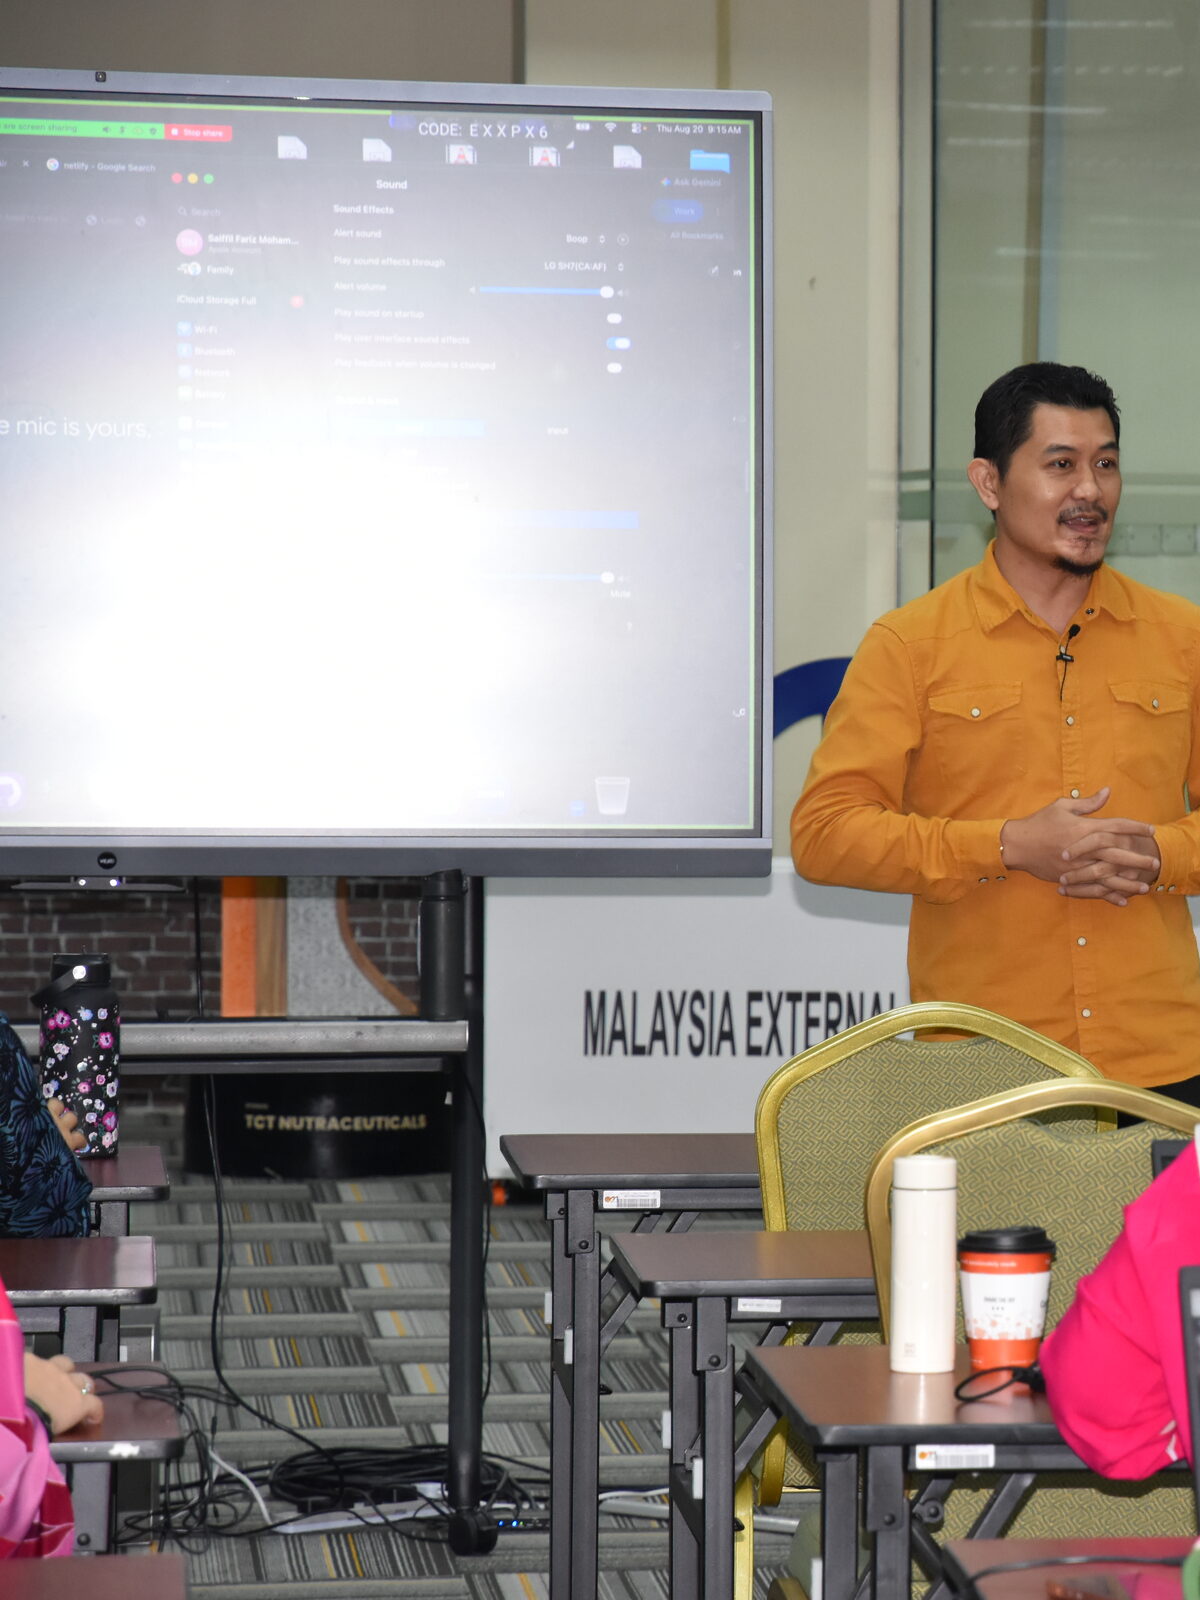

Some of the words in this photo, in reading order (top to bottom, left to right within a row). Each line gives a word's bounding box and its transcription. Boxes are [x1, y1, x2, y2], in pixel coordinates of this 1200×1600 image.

[418, 121, 463, 137] CODE:
[656, 124, 673, 134] Thu
[674, 124, 691, 136] Aug
[692, 125, 704, 134] 20
[97, 162, 126, 173] Google
[128, 163, 156, 173] Search
[376, 178, 408, 191] Sound
[333, 203, 362, 214] Sound
[363, 204, 395, 215] Effects
[333, 228, 354, 238] Alert
[355, 229, 382, 239] sound
[353, 257, 380, 266] sound
[381, 257, 411, 267] effects
[412, 257, 446, 269] through
[207, 264, 234, 276] Family
[16, 416, 57, 437] mic
[63, 417, 80, 437] is
[583, 989, 737, 1057] MALAYSIA
[746, 990, 896, 1056] EXTERN
[245, 1114, 277, 1130] TCT
[278, 1114, 427, 1131] NUTRACEUTICALS
